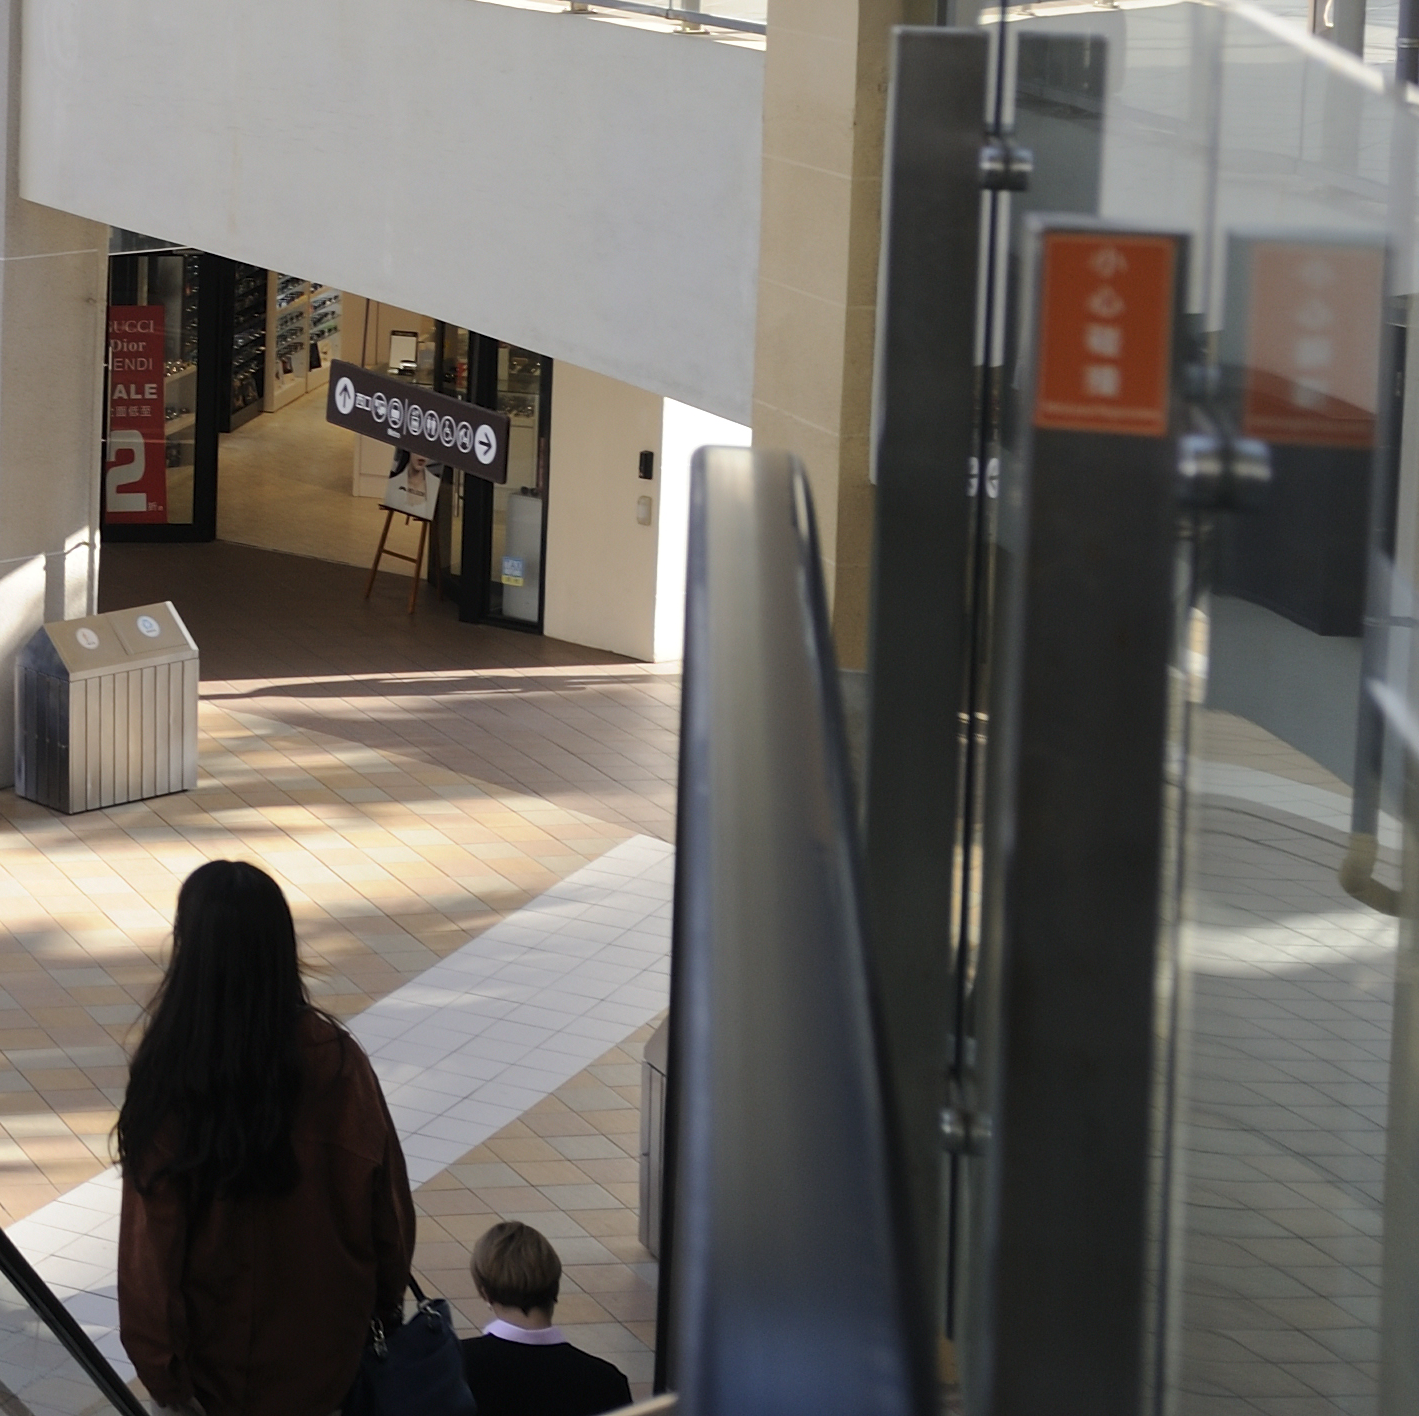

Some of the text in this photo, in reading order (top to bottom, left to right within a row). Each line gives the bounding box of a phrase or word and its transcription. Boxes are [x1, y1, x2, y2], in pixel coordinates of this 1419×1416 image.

[110, 320, 155, 333] UCCI
[110, 339, 147, 352] Dior
[113, 358, 153, 371] ENDI
[112, 383, 159, 399] ALE
